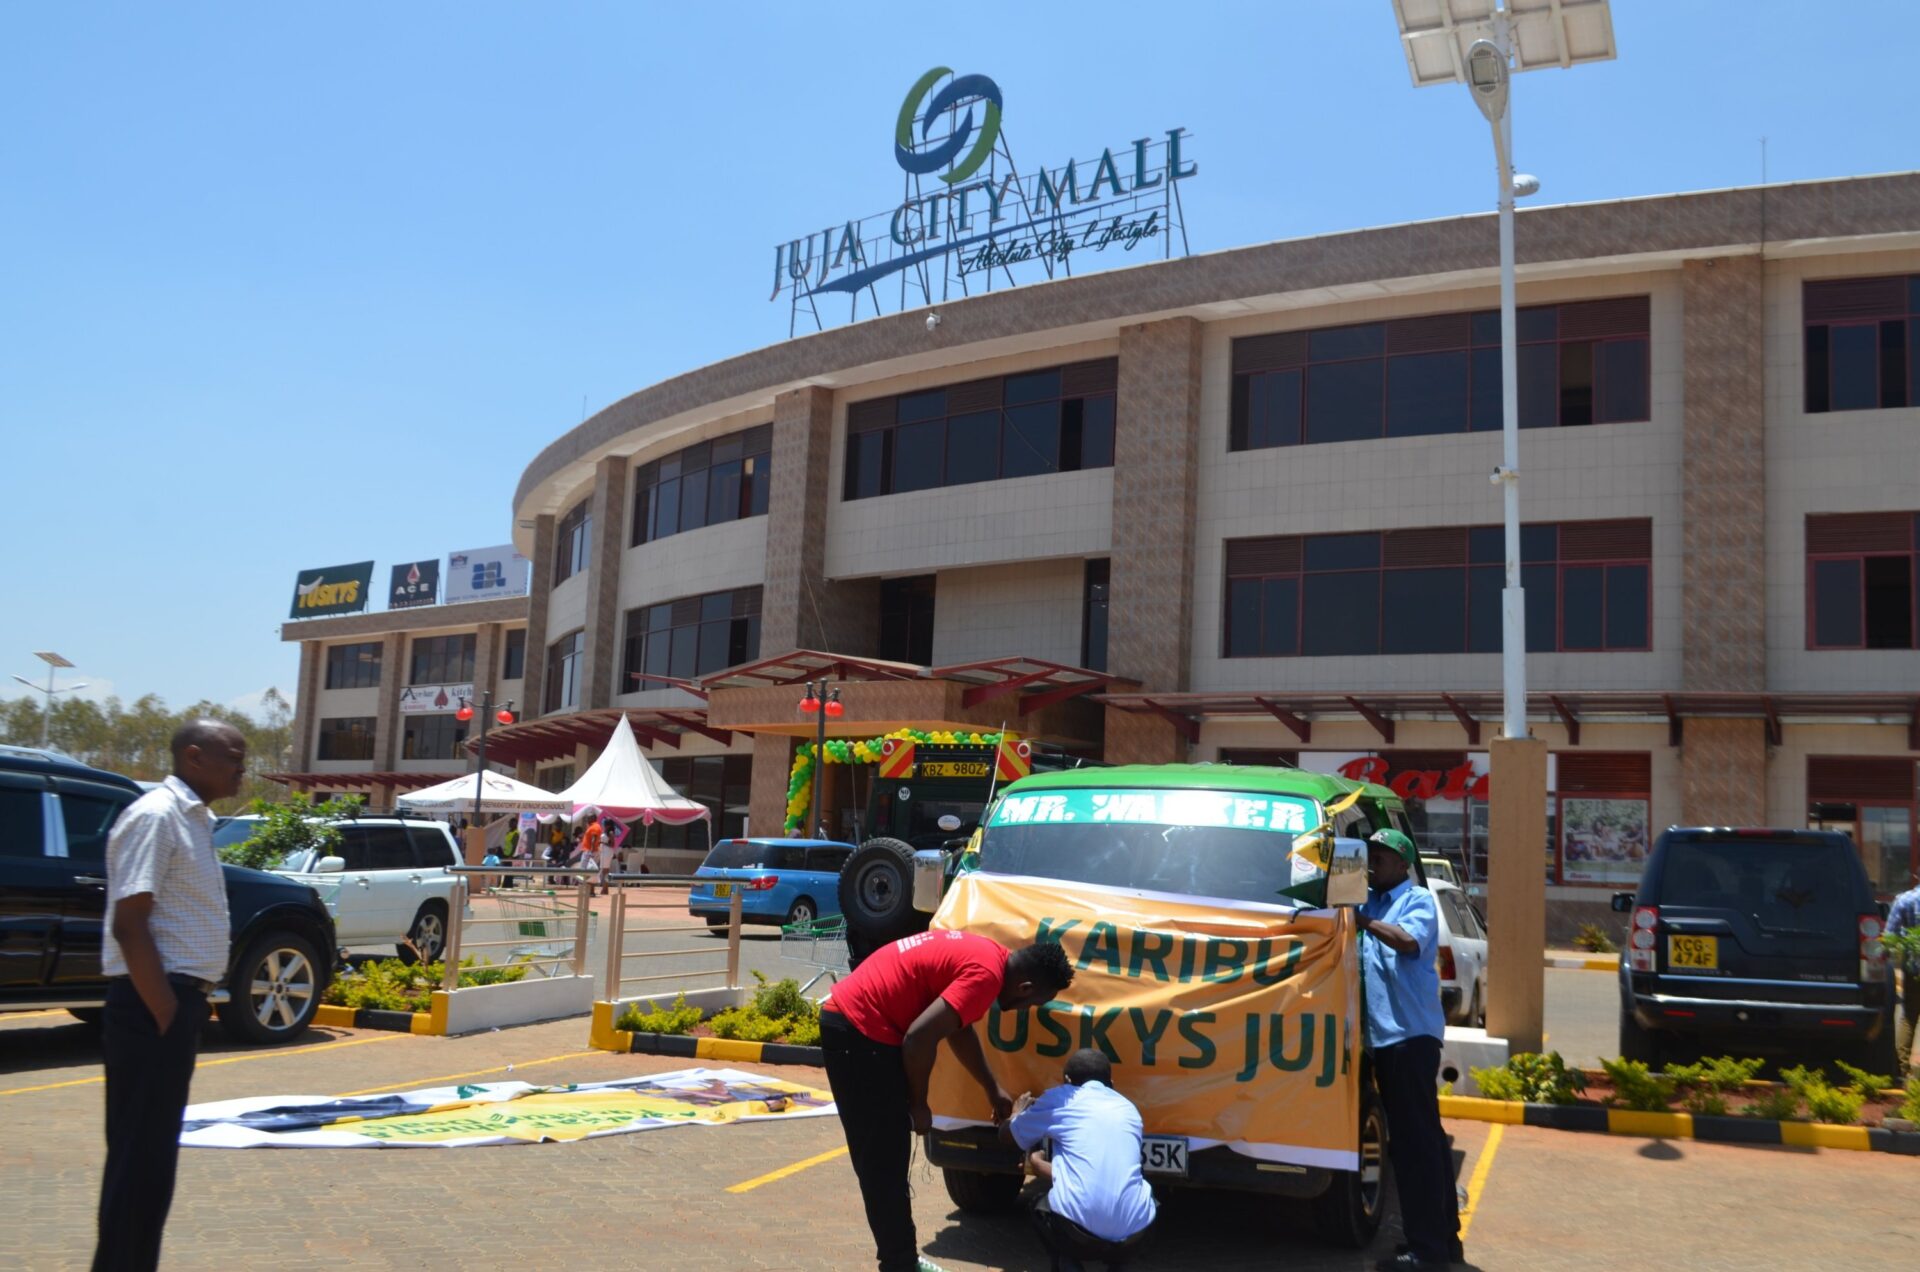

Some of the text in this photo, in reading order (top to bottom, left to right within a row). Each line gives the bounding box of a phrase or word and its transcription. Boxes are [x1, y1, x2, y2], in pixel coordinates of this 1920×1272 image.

[770, 127, 1198, 301] JUJA CITY MALL
[1035, 229, 1075, 263] City
[1082, 211, 1158, 251] Lifestyle
[298, 578, 361, 608] TUSKYS
[395, 583, 429, 595] ACE
[922, 763, 984, 777] KBZ 980Z
[1001, 796, 1074, 821] MR.
[1034, 917, 1307, 985] KARIBU
[1673, 937, 1704, 952] KCG
[1674, 950, 1712, 965] 474F
[987, 1000, 1348, 1088] USKYS JUJ
